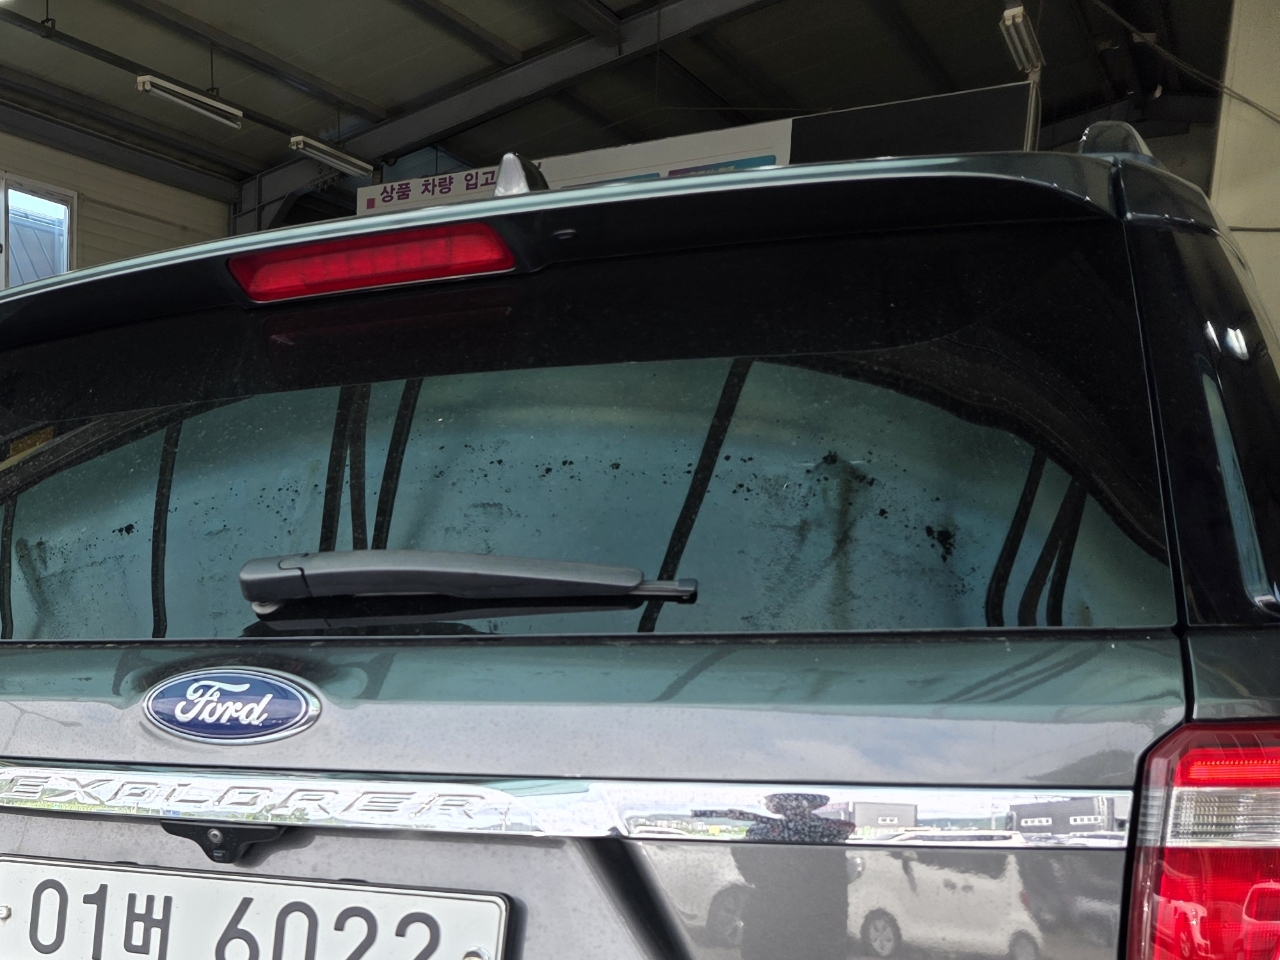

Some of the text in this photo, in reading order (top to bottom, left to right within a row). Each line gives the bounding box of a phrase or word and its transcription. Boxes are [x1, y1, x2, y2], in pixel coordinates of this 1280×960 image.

[380, 182, 412, 203] 상품
[421, 175, 454, 196] 차량
[175, 680, 273, 726] Ford
[0, 774, 488, 820] EXPLORER
